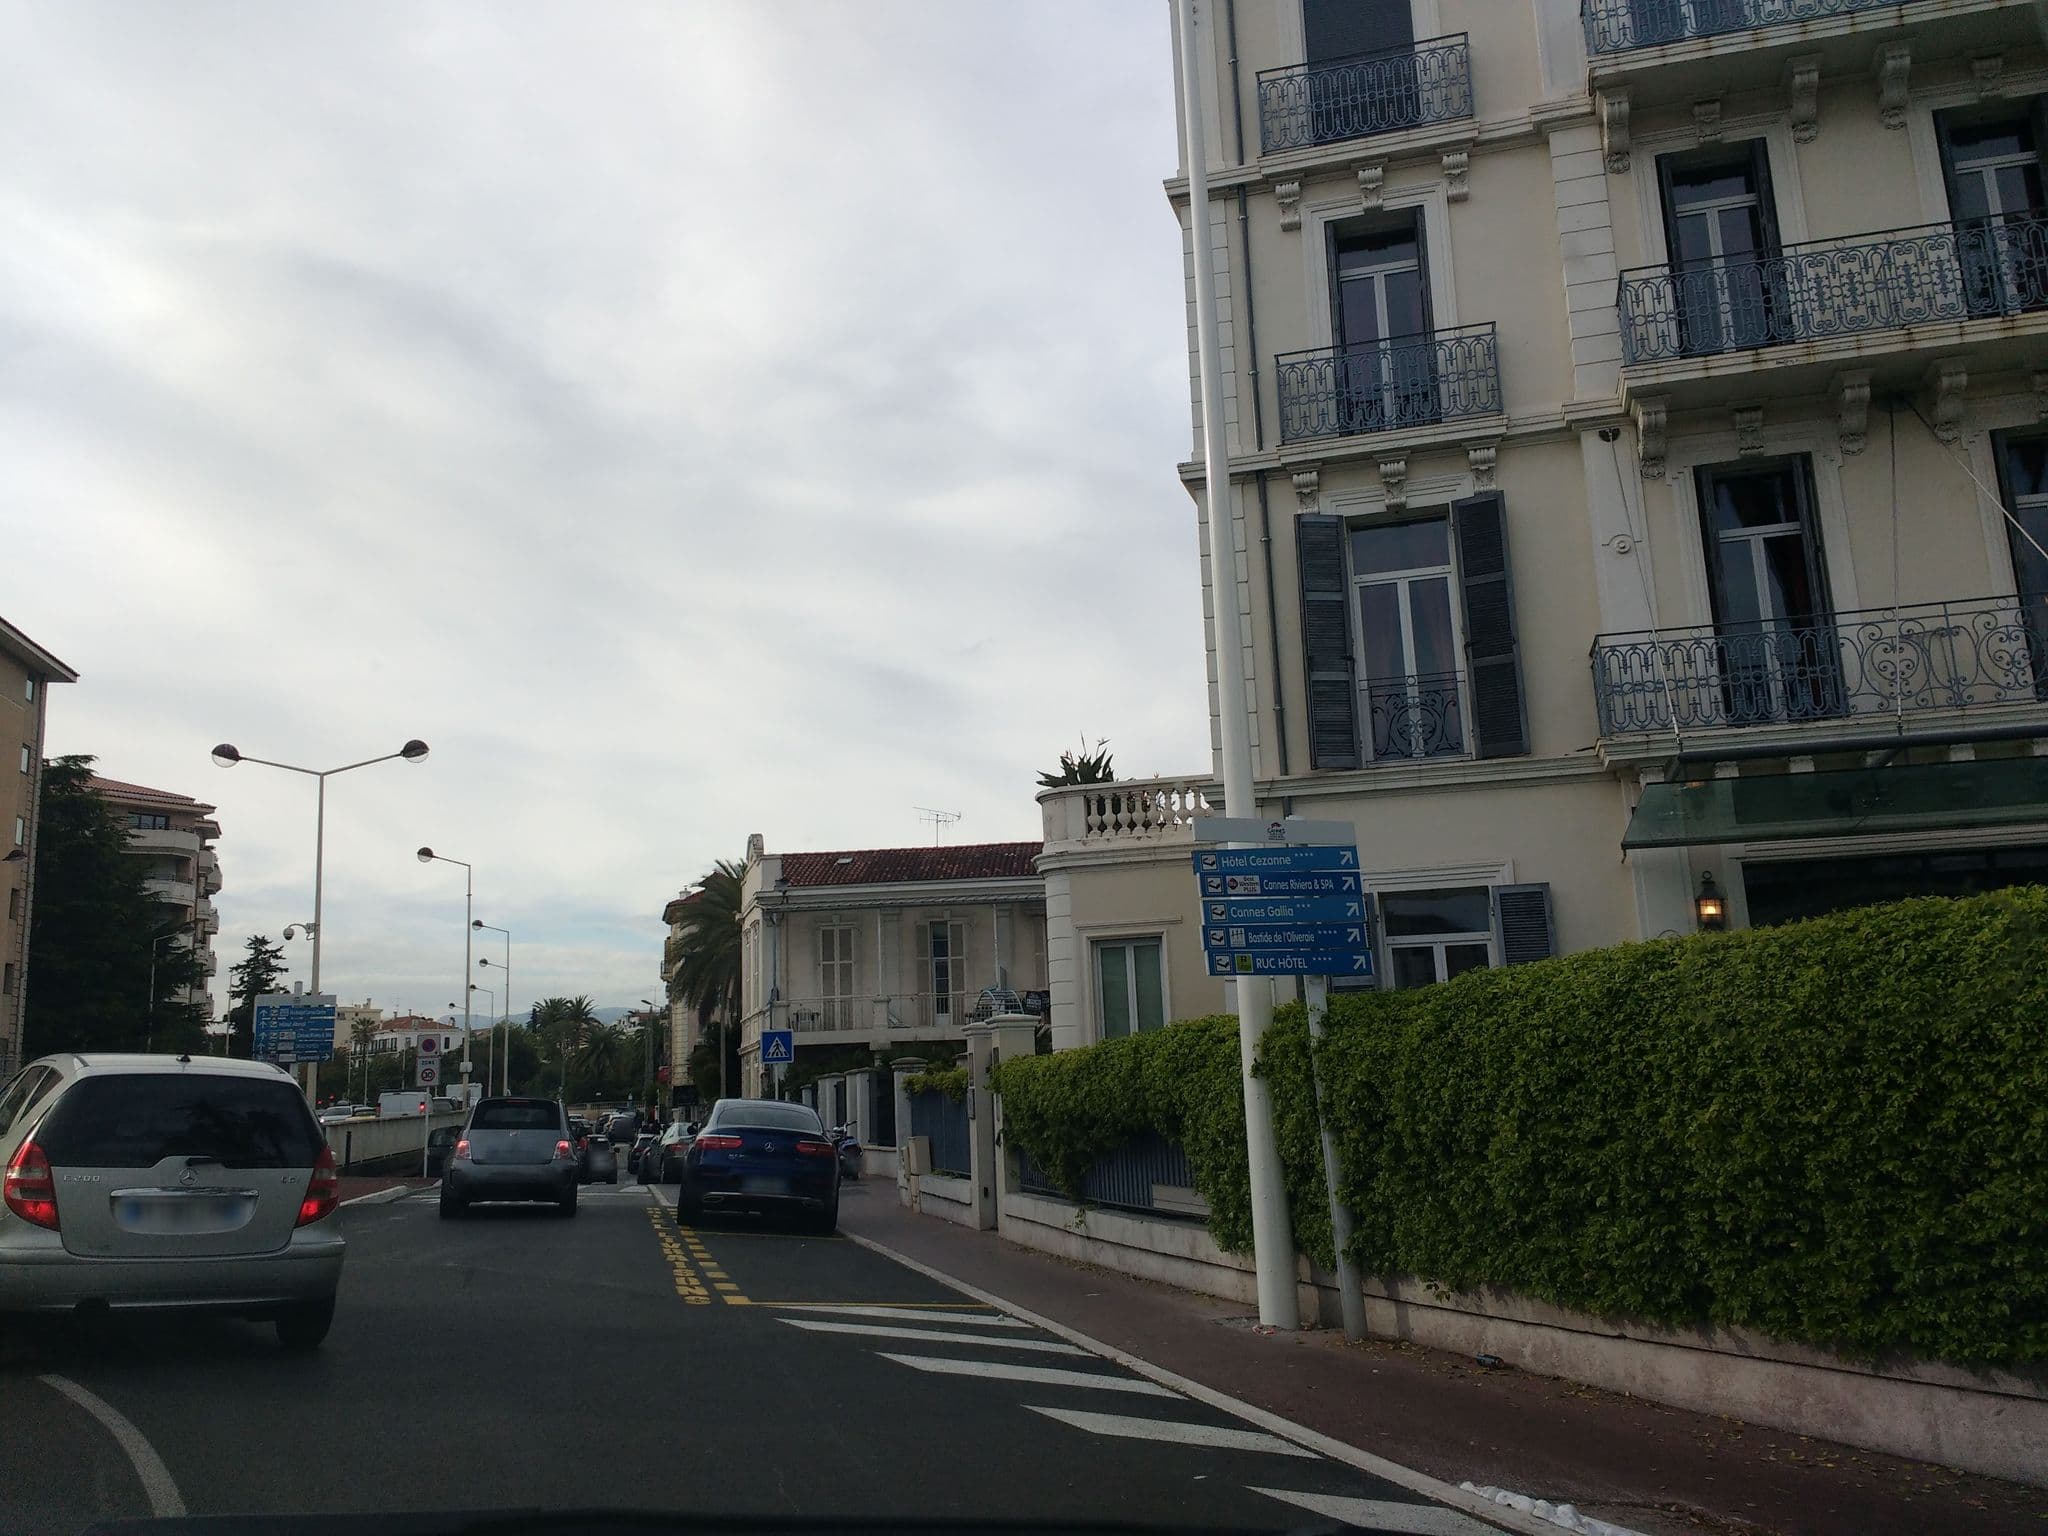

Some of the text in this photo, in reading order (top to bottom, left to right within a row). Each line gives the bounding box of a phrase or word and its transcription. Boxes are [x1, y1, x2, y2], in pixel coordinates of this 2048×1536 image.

[1222, 855, 1291, 867] Hôtel Cezanne
[1263, 880, 1289, 890] Cannes
[1290, 879, 1313, 890] Riviera
[1321, 879, 1335, 890] SPA
[1230, 905, 1294, 918] Cannes Gallia
[1248, 932, 1272, 943] Bastide
[1273, 931, 1282, 943] de
[1256, 955, 1308, 969] RUC HÔTEL
